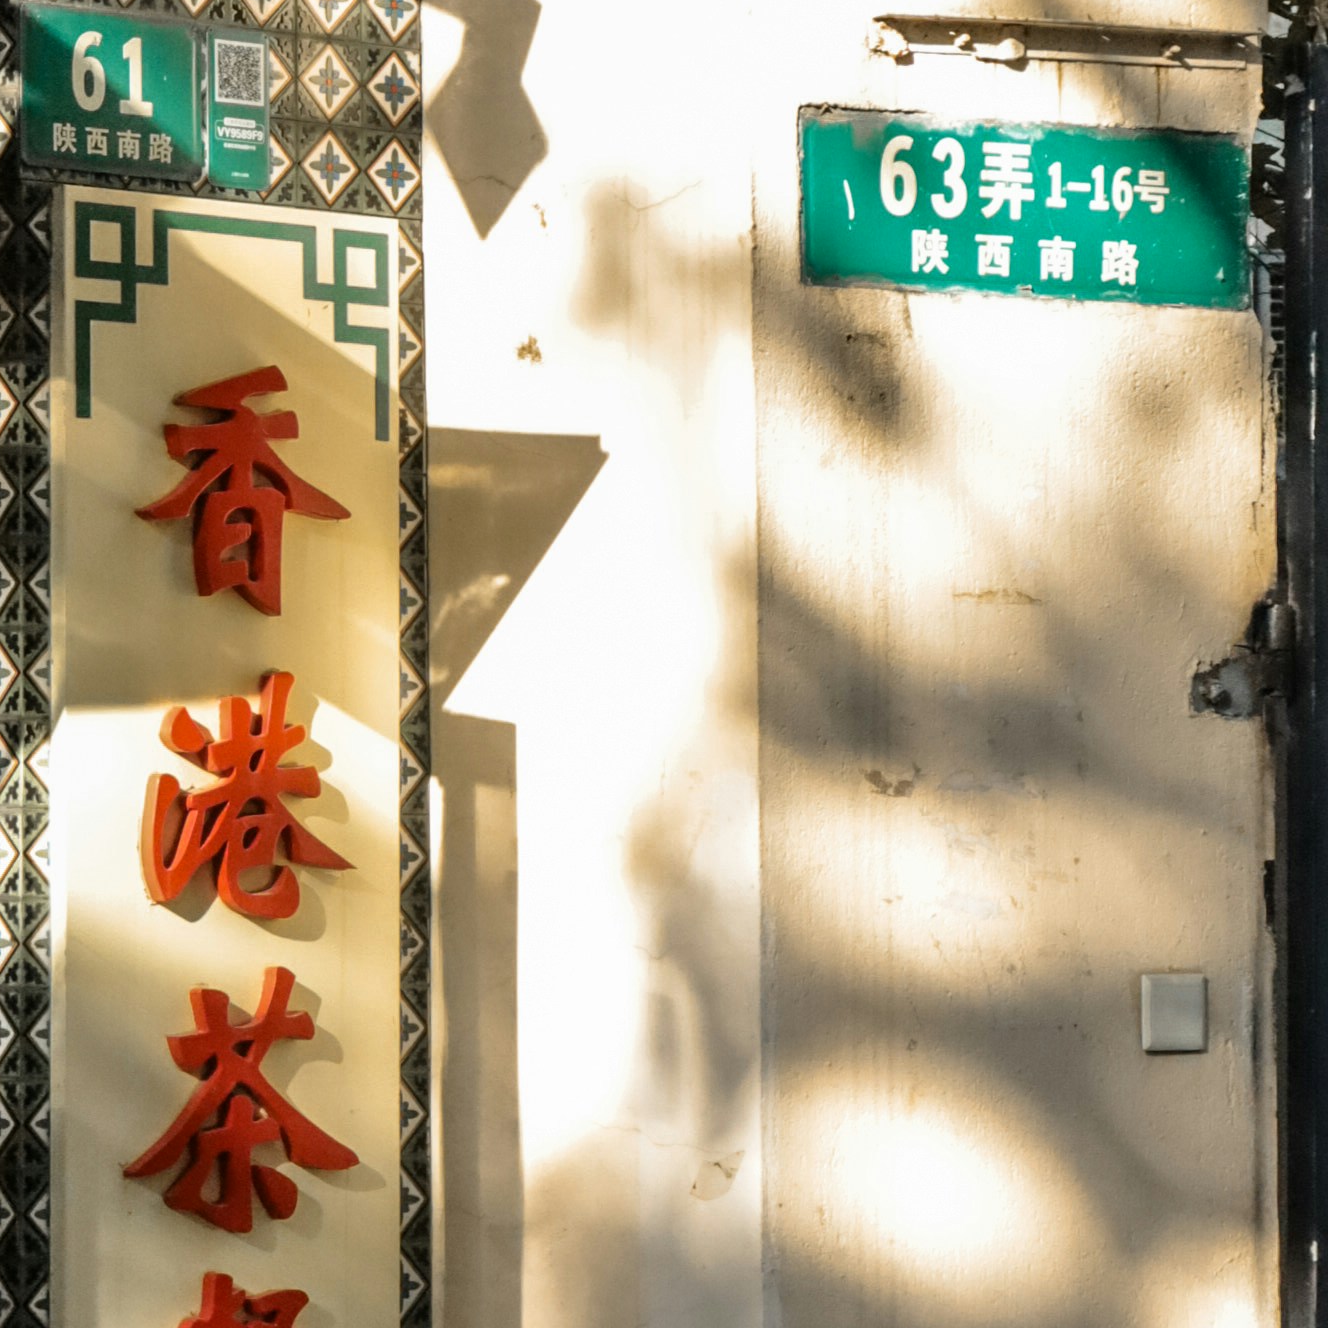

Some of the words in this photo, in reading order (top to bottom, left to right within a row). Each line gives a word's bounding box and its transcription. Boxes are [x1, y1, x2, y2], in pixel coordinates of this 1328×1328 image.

[71, 30, 154, 118] 61
[52, 122, 174, 164] 陕西南路
[910, 228, 1140, 286] 陕西南路
